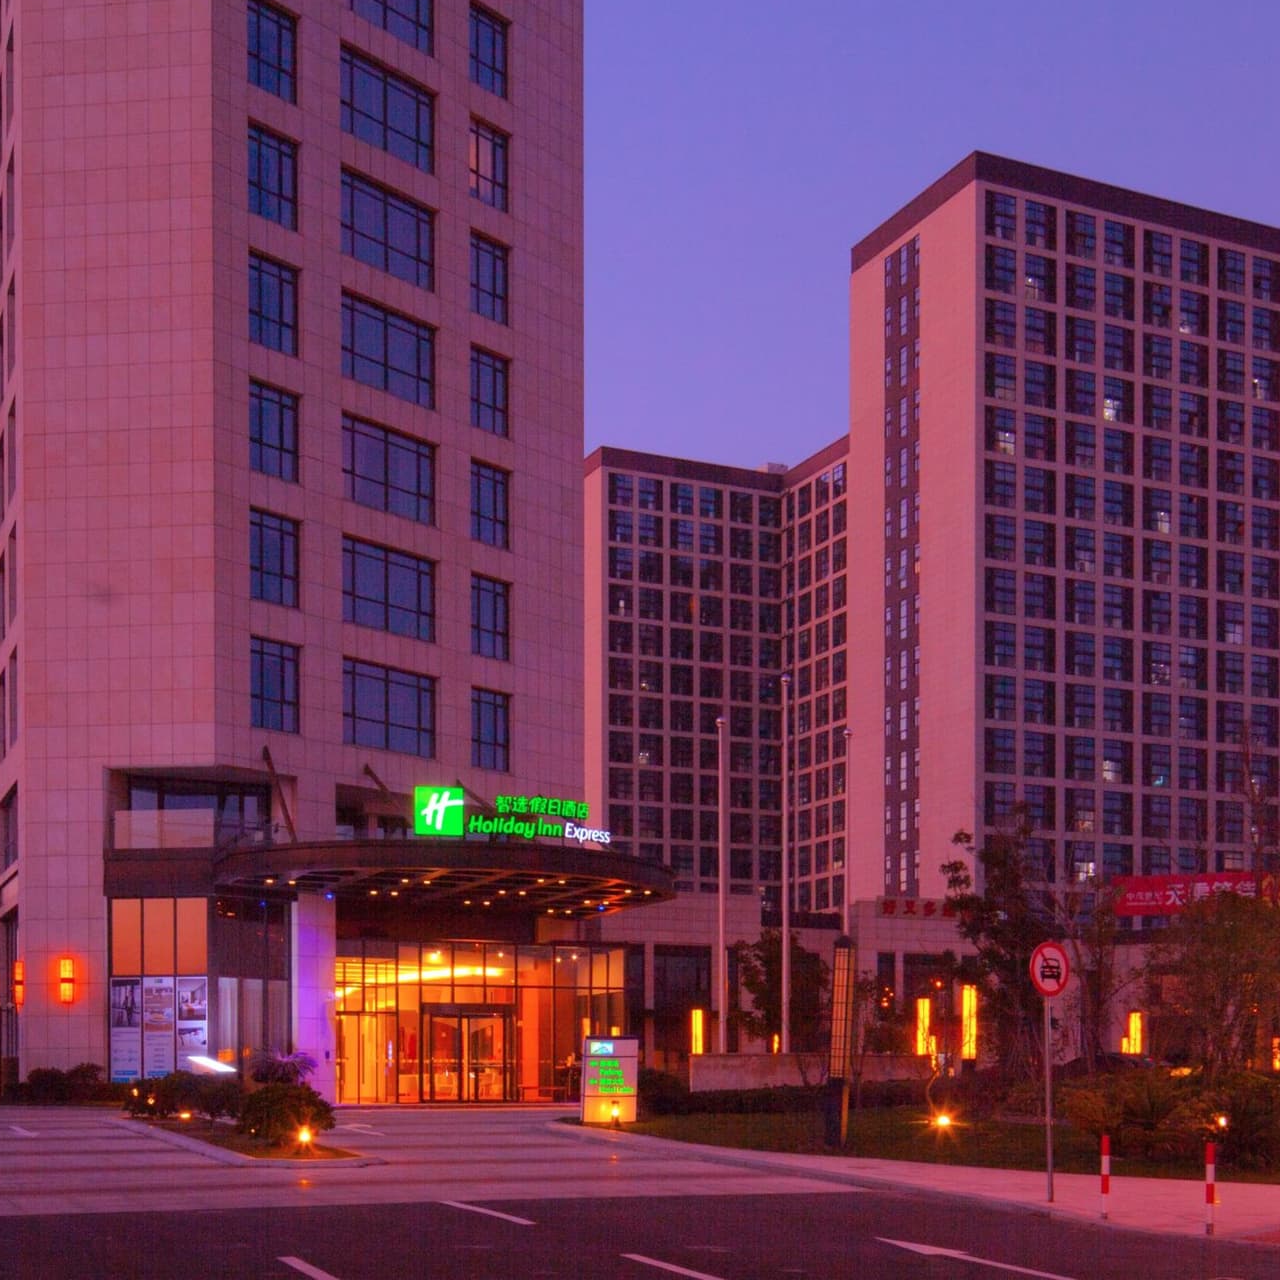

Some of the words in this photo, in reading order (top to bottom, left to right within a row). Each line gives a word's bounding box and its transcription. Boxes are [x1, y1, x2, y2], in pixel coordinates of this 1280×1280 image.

[495, 795, 590, 819] 智选假日酒店
[469, 815, 536, 839] Holiday
[538, 818, 562, 837] Inn
[564, 822, 611, 844] Express
